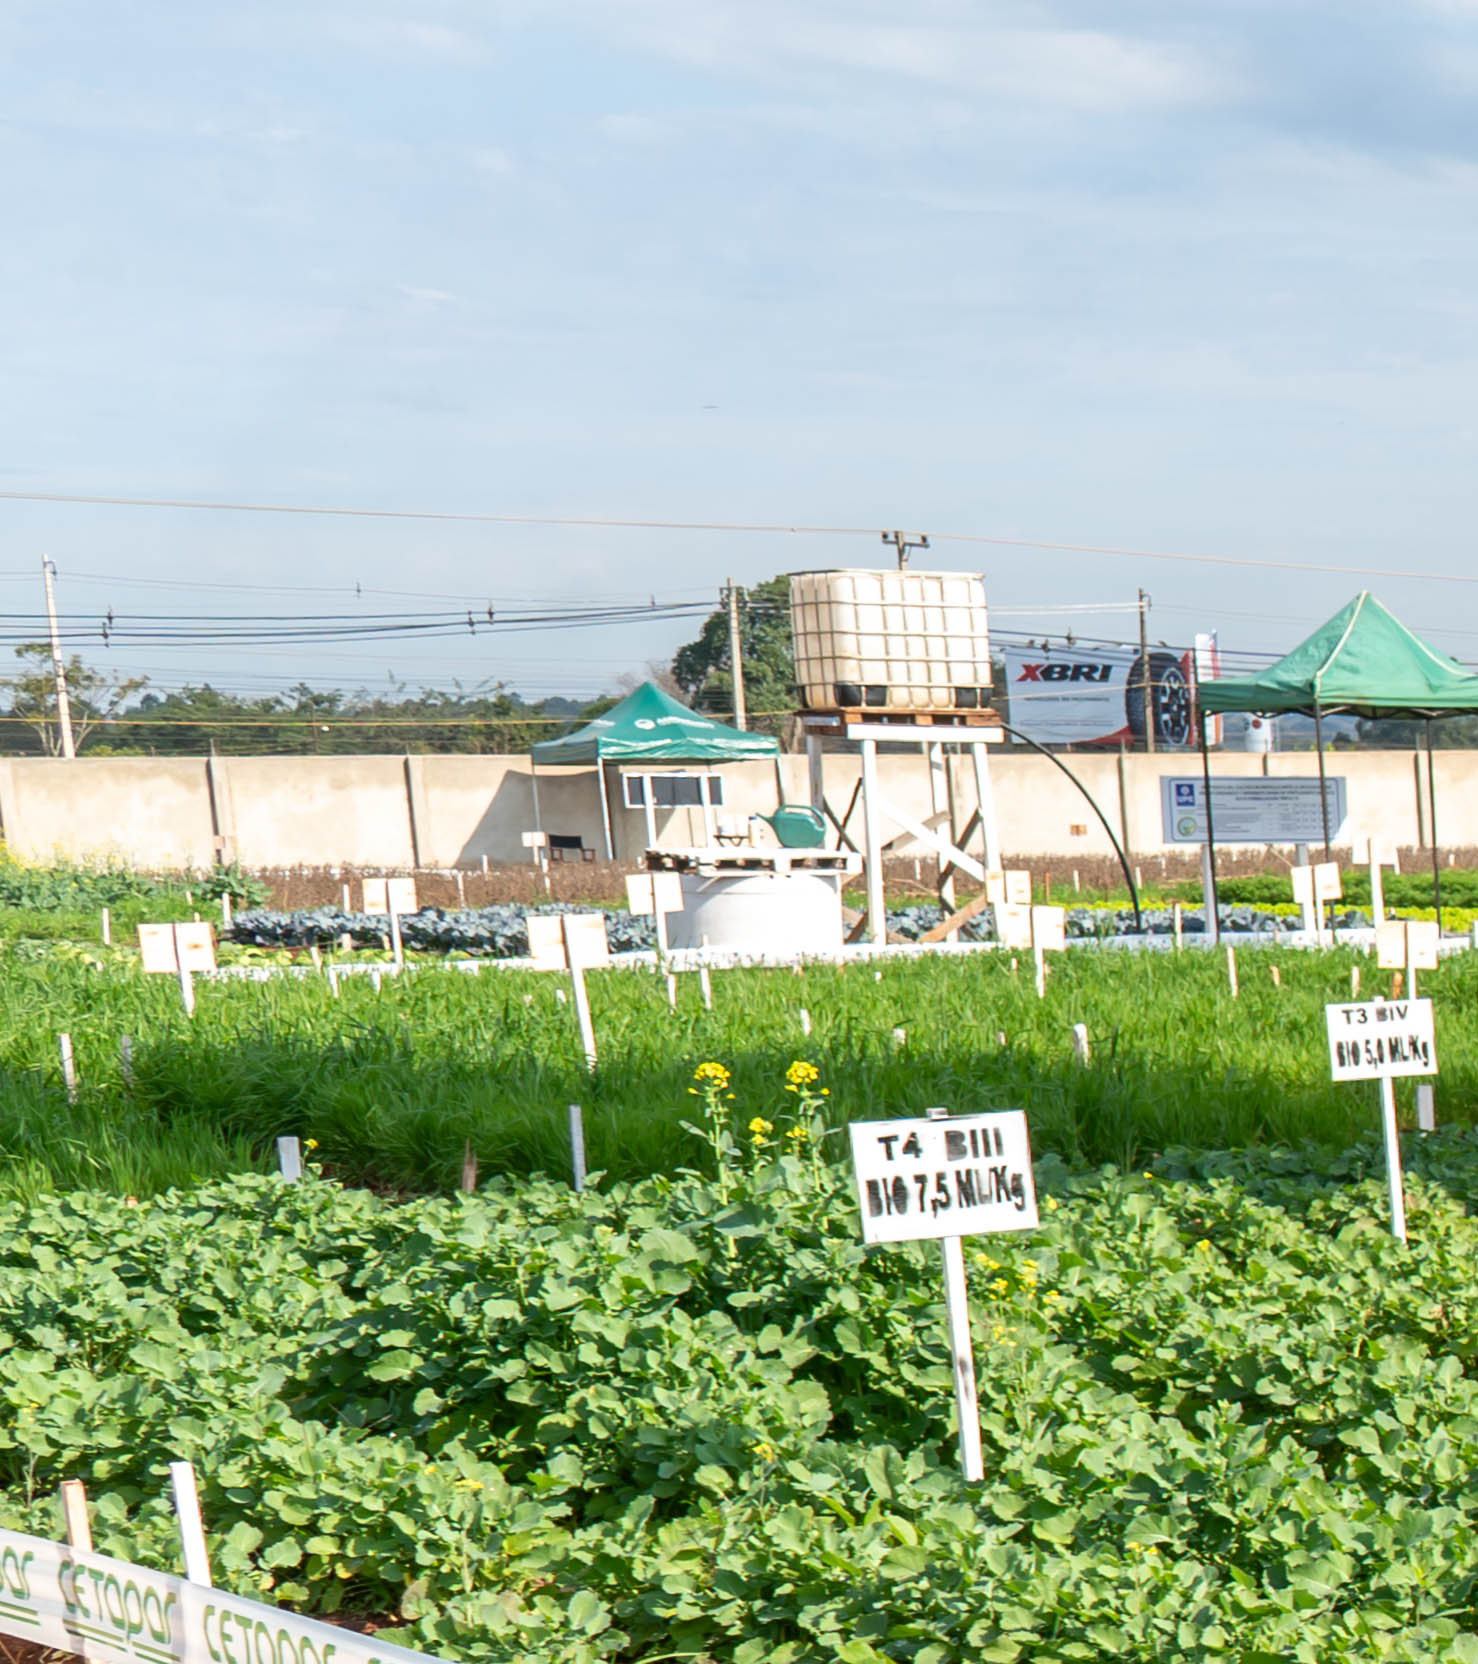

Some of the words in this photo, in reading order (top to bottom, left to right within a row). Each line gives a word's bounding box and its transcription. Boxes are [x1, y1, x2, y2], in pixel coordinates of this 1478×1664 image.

[1016, 663, 1112, 681] XBRI
[1341, 1008, 1368, 1024] T3
[1376, 1004, 1408, 1022] BIV
[1337, 1040, 1360, 1067] BIO
[877, 1131, 922, 1161] T4
[944, 1127, 1004, 1162] BIII
[866, 1175, 909, 1217] BIO
